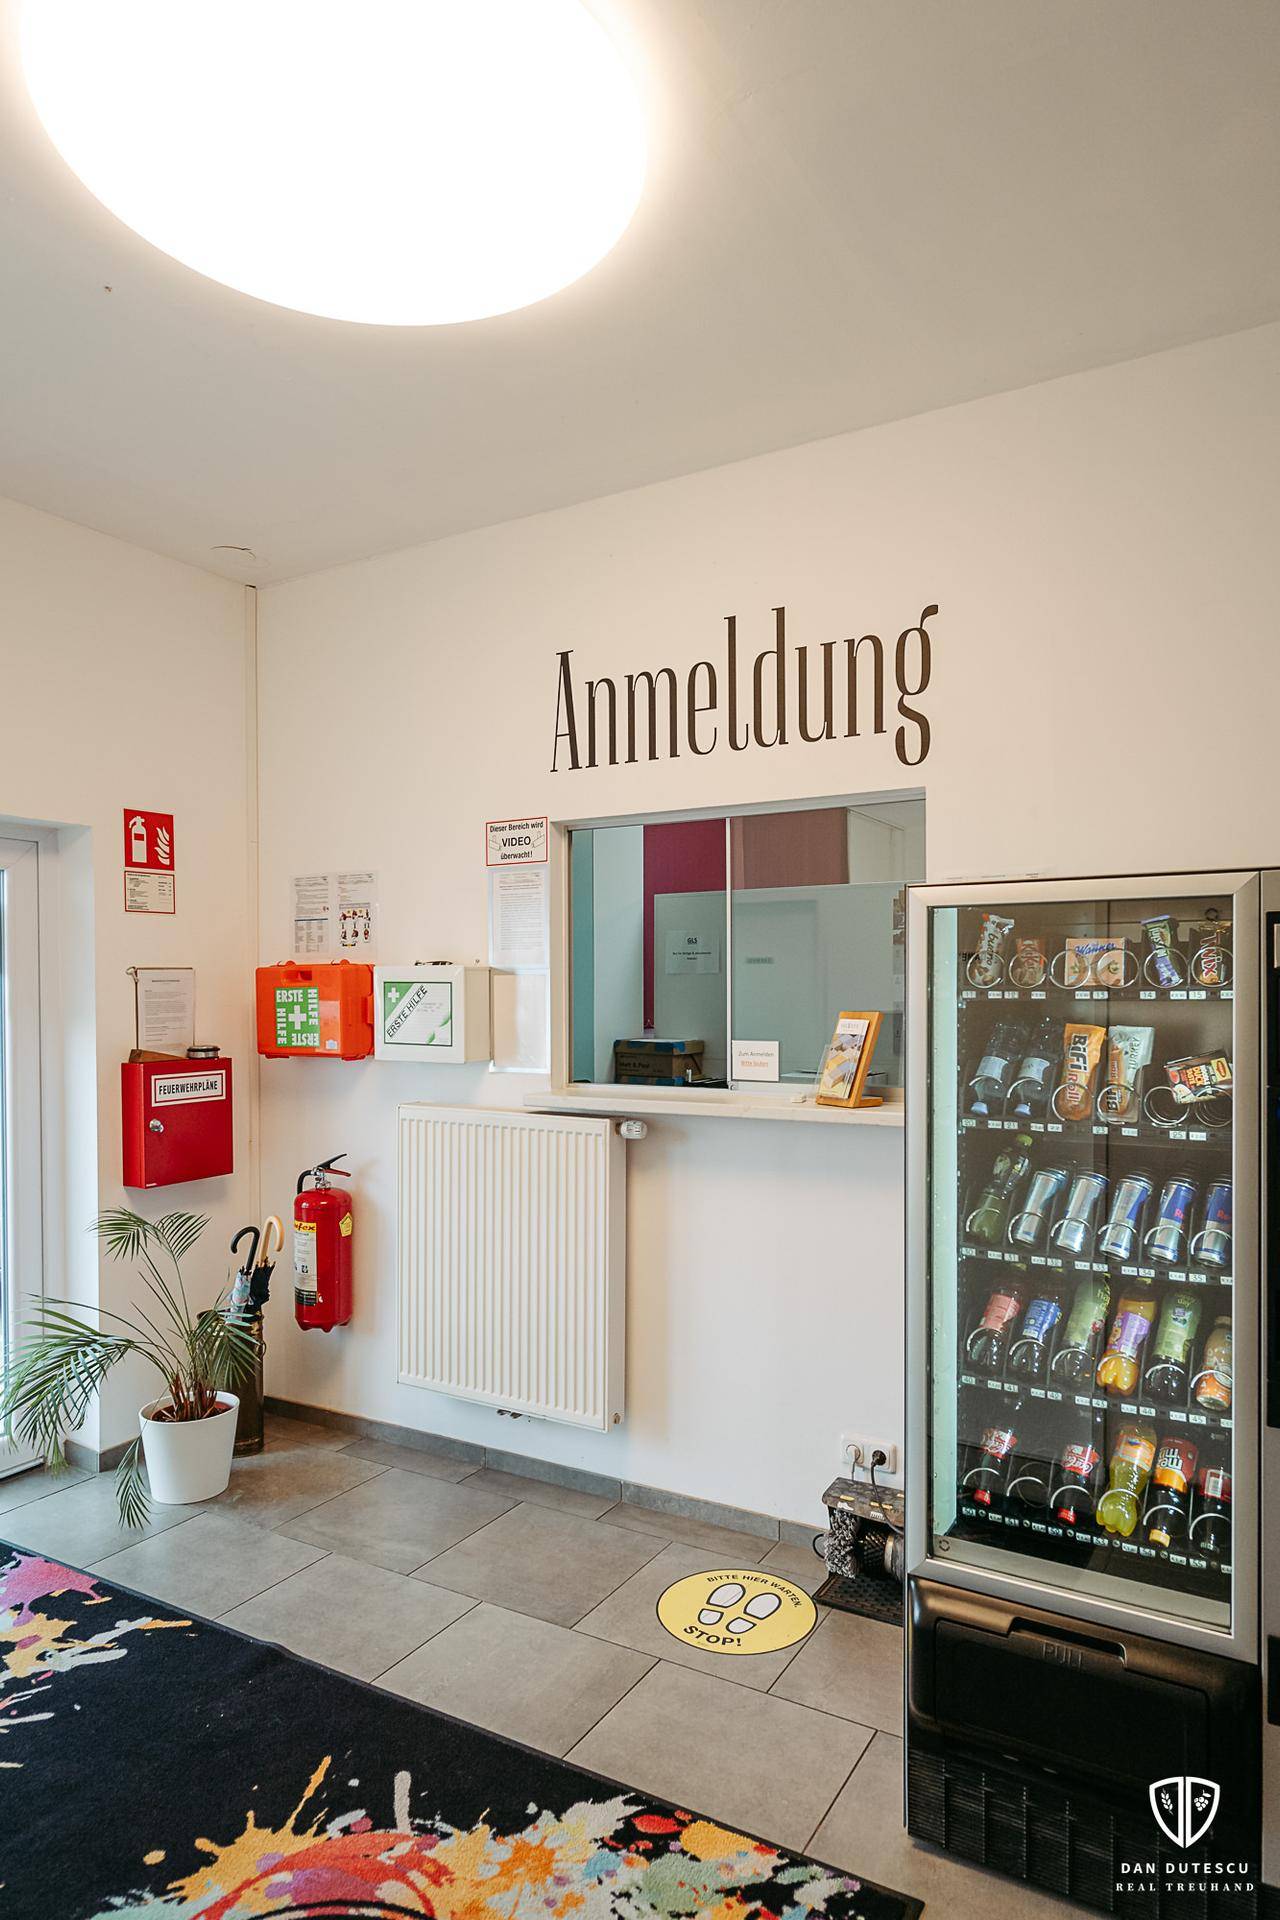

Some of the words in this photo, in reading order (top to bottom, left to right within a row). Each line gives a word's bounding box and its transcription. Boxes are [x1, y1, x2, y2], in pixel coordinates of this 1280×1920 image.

[550, 604, 939, 772] Anmeldung
[508, 823, 529, 831] Bereich
[501, 836, 531, 847] VIDEO
[276, 990, 304, 1003] ERSTE
[308, 988, 320, 1025] HILFE
[386, 1010, 408, 1038] ERSTE
[405, 985, 428, 1012] HILFE
[277, 1007, 287, 1045] HILFE
[291, 1033, 320, 1047] ERSTE
[159, 1080, 218, 1096] FEUERWEHRPLÄNE
[706, 1574, 739, 1582] BITTE
[742, 1575, 769, 1585] HIER
[684, 1625, 742, 1647] STOP!
